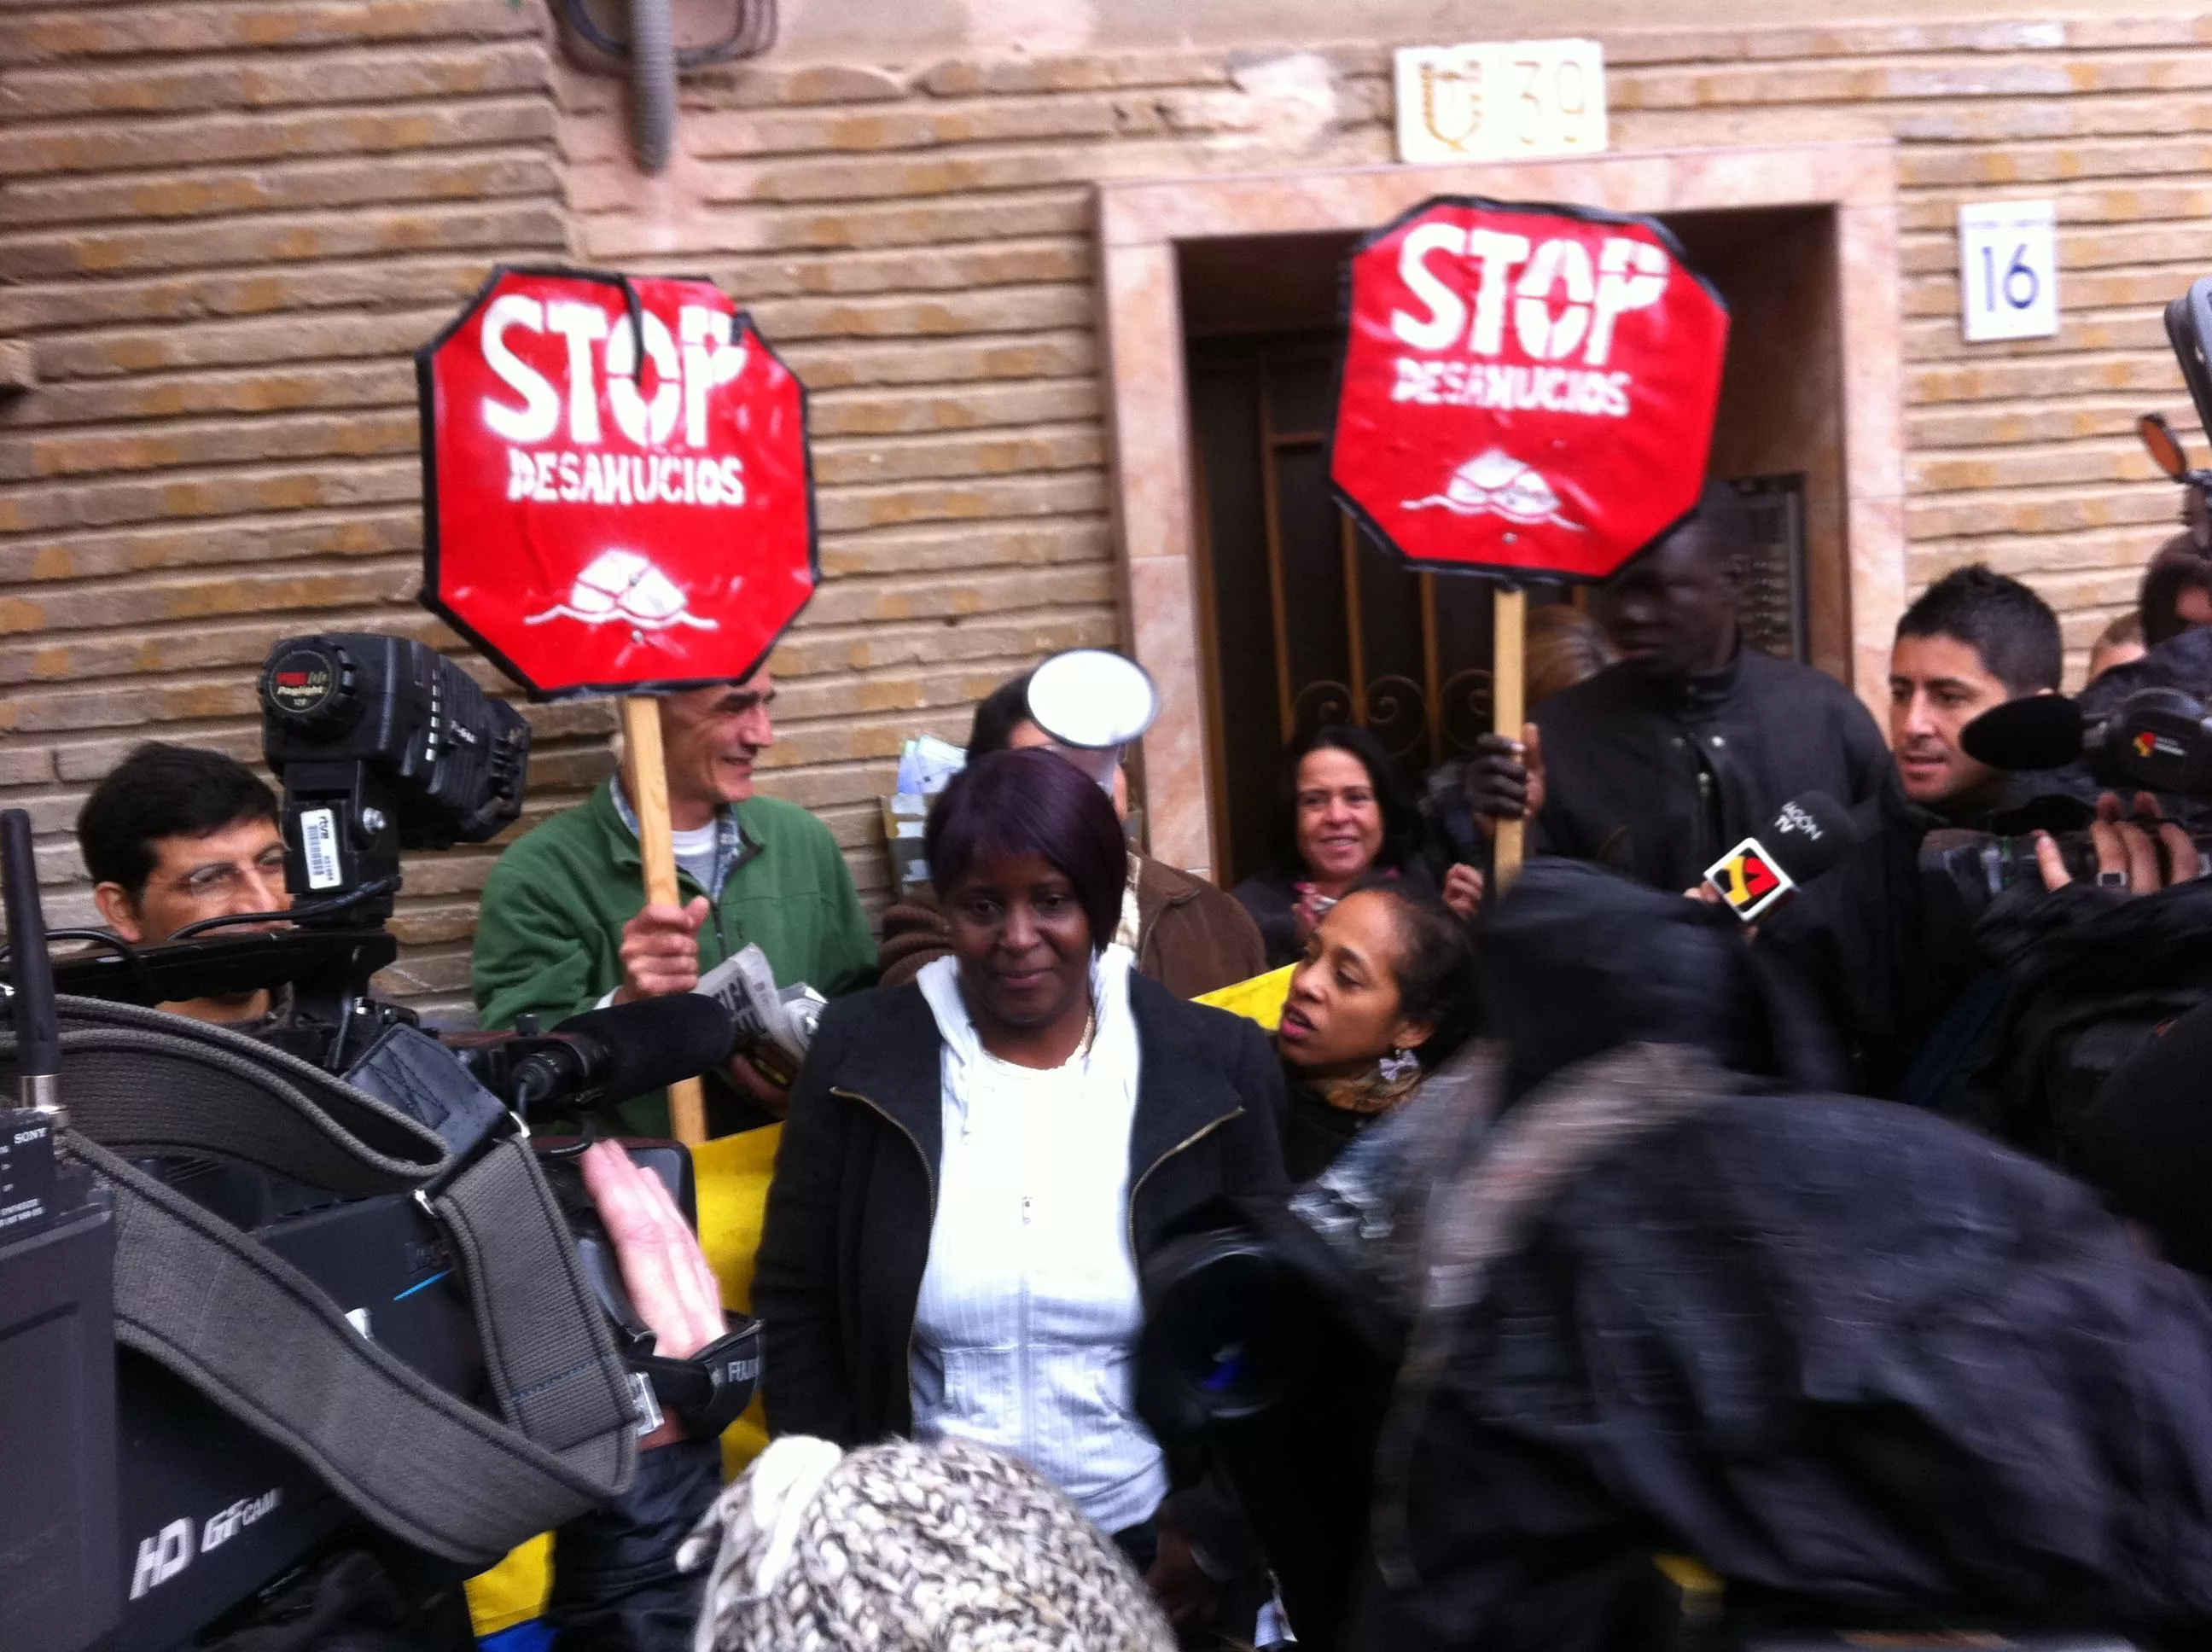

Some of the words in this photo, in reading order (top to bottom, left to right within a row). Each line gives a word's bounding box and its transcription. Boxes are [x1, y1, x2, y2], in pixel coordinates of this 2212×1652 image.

[1391, 221, 1669, 365] STOP
[1981, 242, 2040, 311] 16
[480, 294, 748, 448] STOP
[1389, 357, 1632, 418] DESAHUCIOS
[507, 447, 745, 507] DESAHUCIOS
[318, 815, 329, 840] rtve
[14, 1127, 48, 1143] SONY
[130, 1516, 195, 1600] HD
